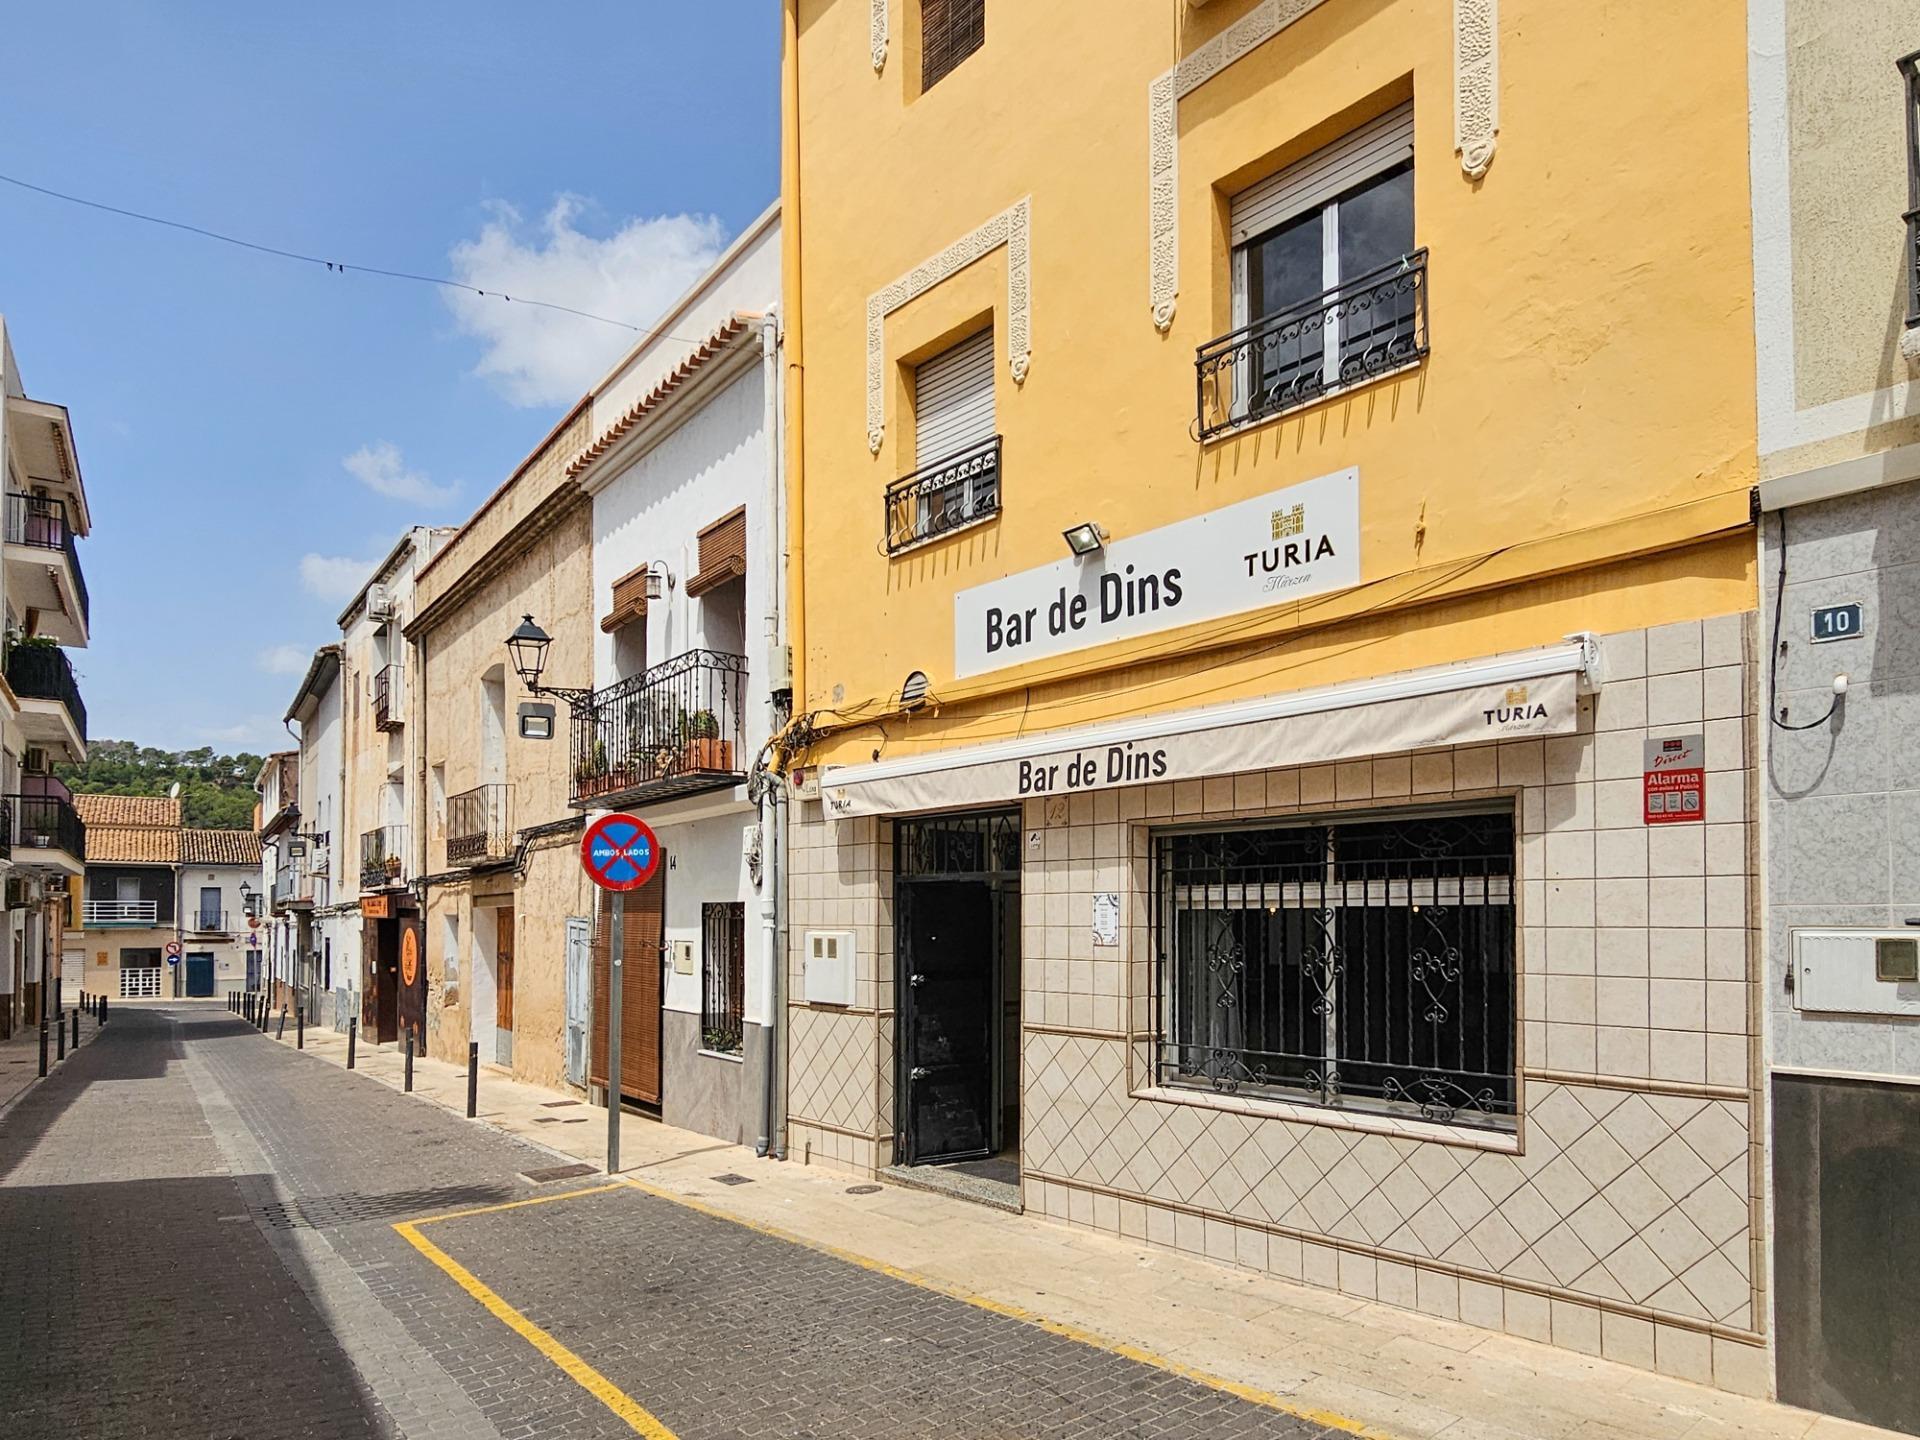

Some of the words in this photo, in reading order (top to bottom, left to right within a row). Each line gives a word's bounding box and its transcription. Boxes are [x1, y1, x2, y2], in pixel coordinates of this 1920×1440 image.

[1244, 534, 1336, 577] TURIA
[986, 607, 1037, 653] Bar
[1048, 586, 1087, 636] de
[1100, 563, 1183, 623] Dins
[1824, 610, 1849, 633] 10
[1483, 703, 1548, 725] TURIA
[1019, 760, 1058, 794] Bar
[1067, 752, 1097, 789] de
[1107, 742, 1167, 783] Dins
[1648, 773, 1699, 785] Alarma
[830, 800, 851, 810] TURIA
[593, 849, 620, 857] AMBOS
[623, 848, 650, 857] LADOS
